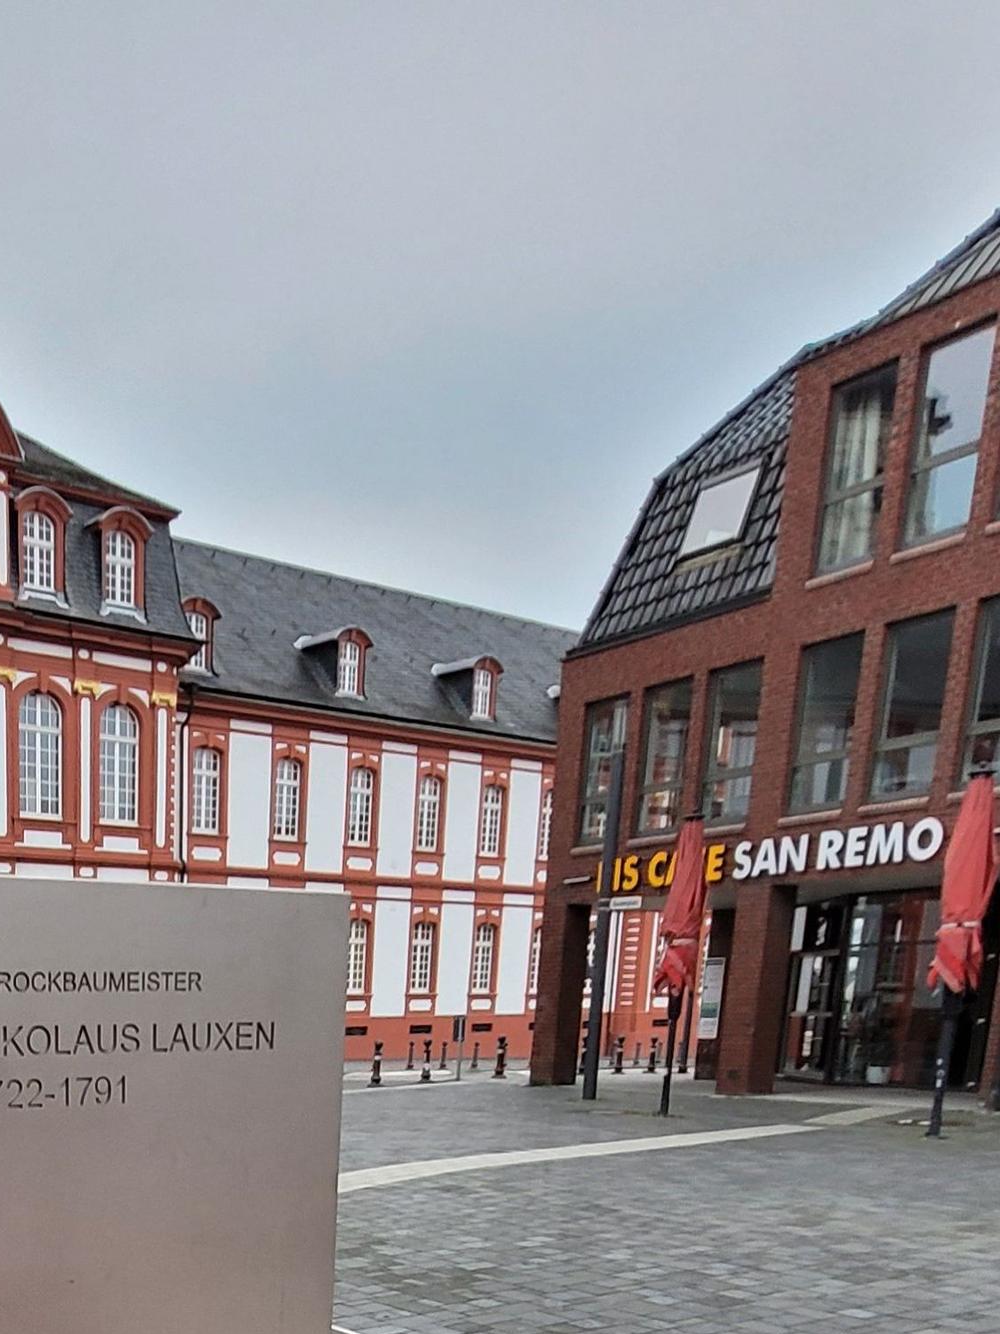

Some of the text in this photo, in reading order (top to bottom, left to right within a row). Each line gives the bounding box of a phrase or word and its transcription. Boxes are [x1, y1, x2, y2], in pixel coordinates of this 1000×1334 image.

[648, 844, 726, 888] CE
[732, 834, 809, 880] SAN
[816, 816, 944, 871] REMO
[152, 1020, 275, 1052] LAUXEN
